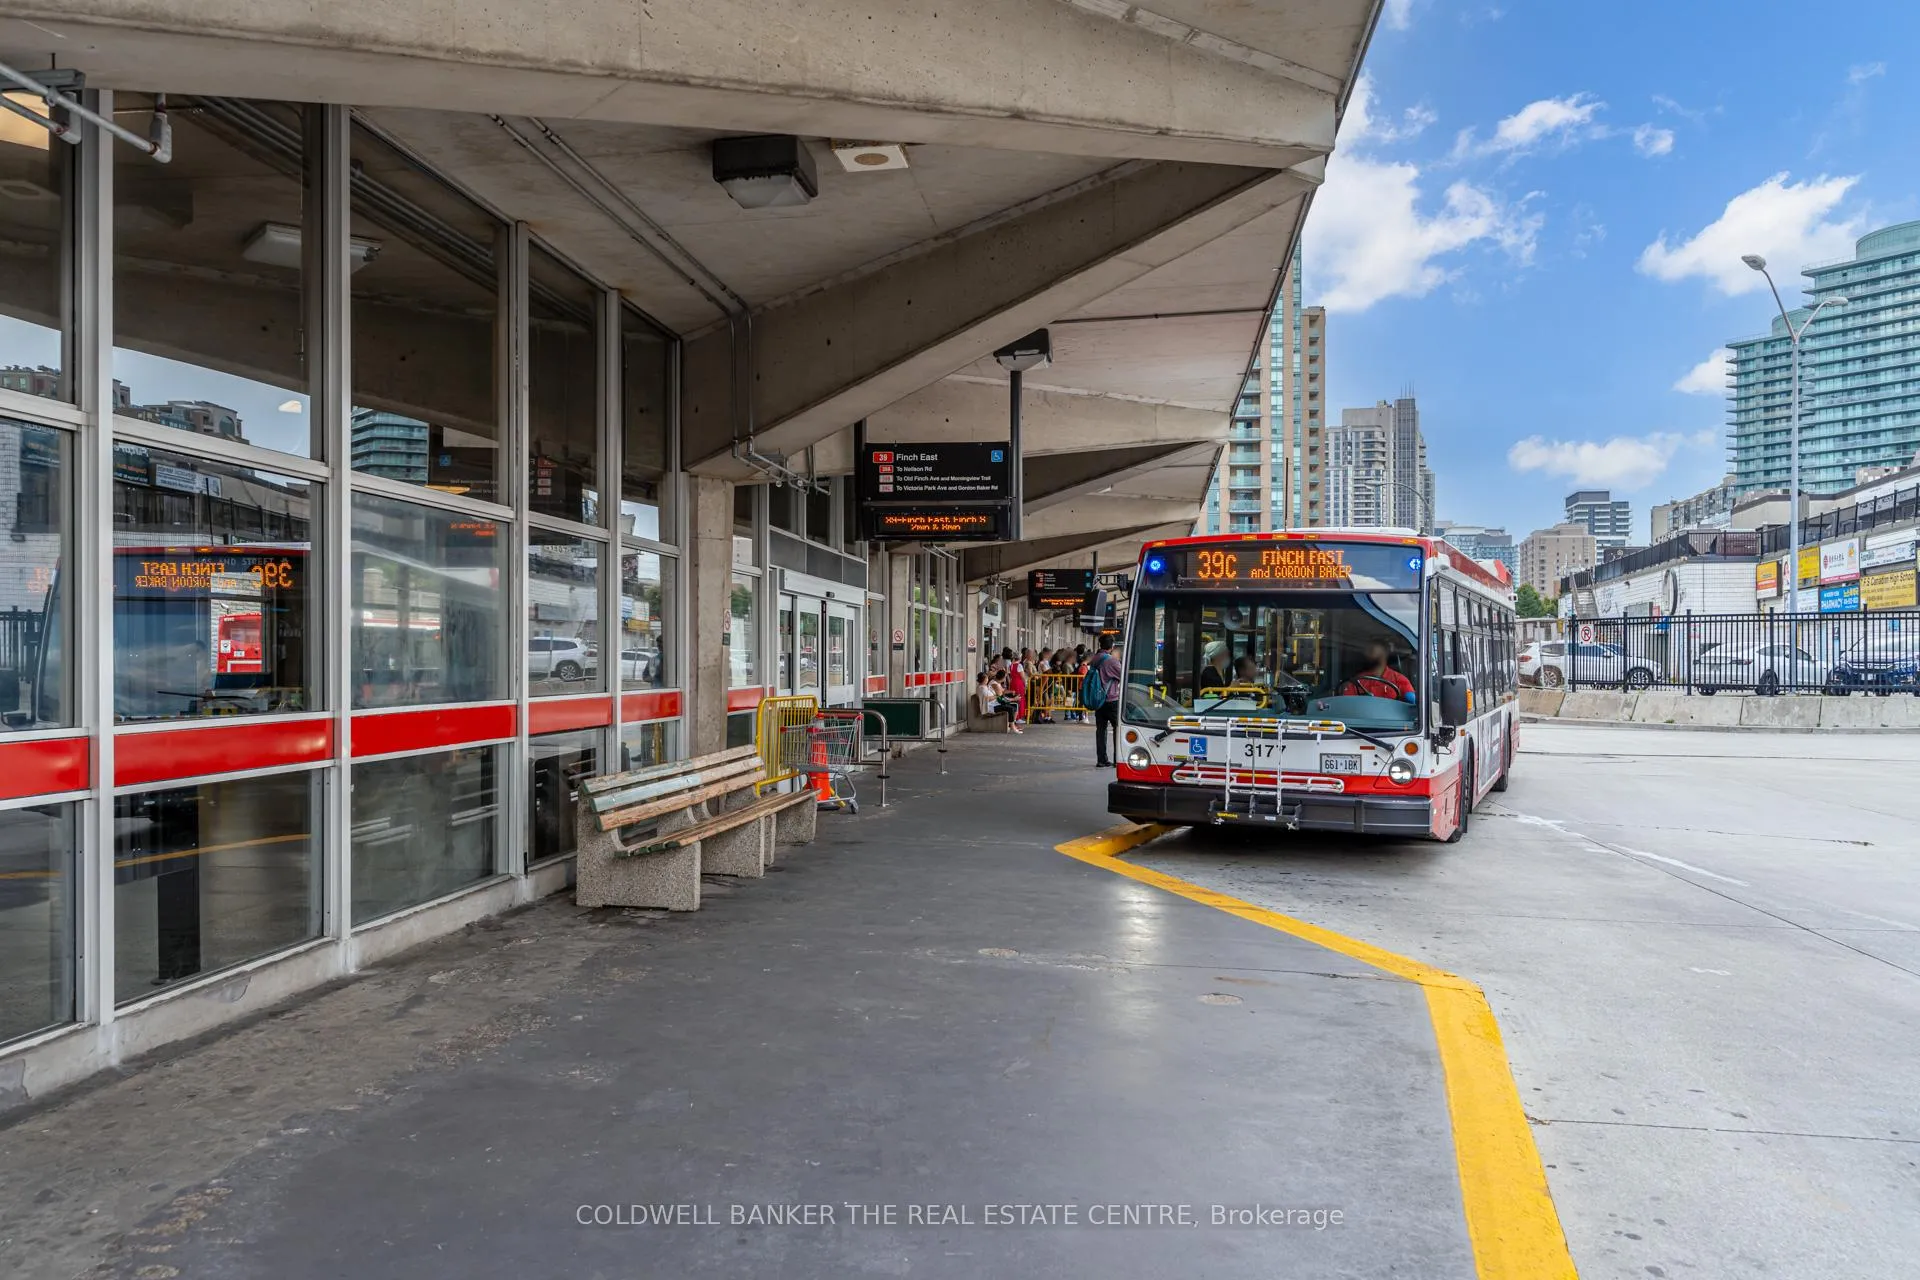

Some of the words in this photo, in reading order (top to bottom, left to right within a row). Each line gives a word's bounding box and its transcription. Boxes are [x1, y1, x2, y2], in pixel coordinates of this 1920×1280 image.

[879, 453, 888, 462] 39
[896, 453, 919, 461] Finch
[920, 453, 938, 461] East
[1262, 550, 1305, 565] FINCH
[1309, 550, 1345, 565] EAST
[1198, 551, 1237, 579] 39C
[1274, 565, 1315, 578] GORDON
[1319, 565, 1352, 578] BAKER
